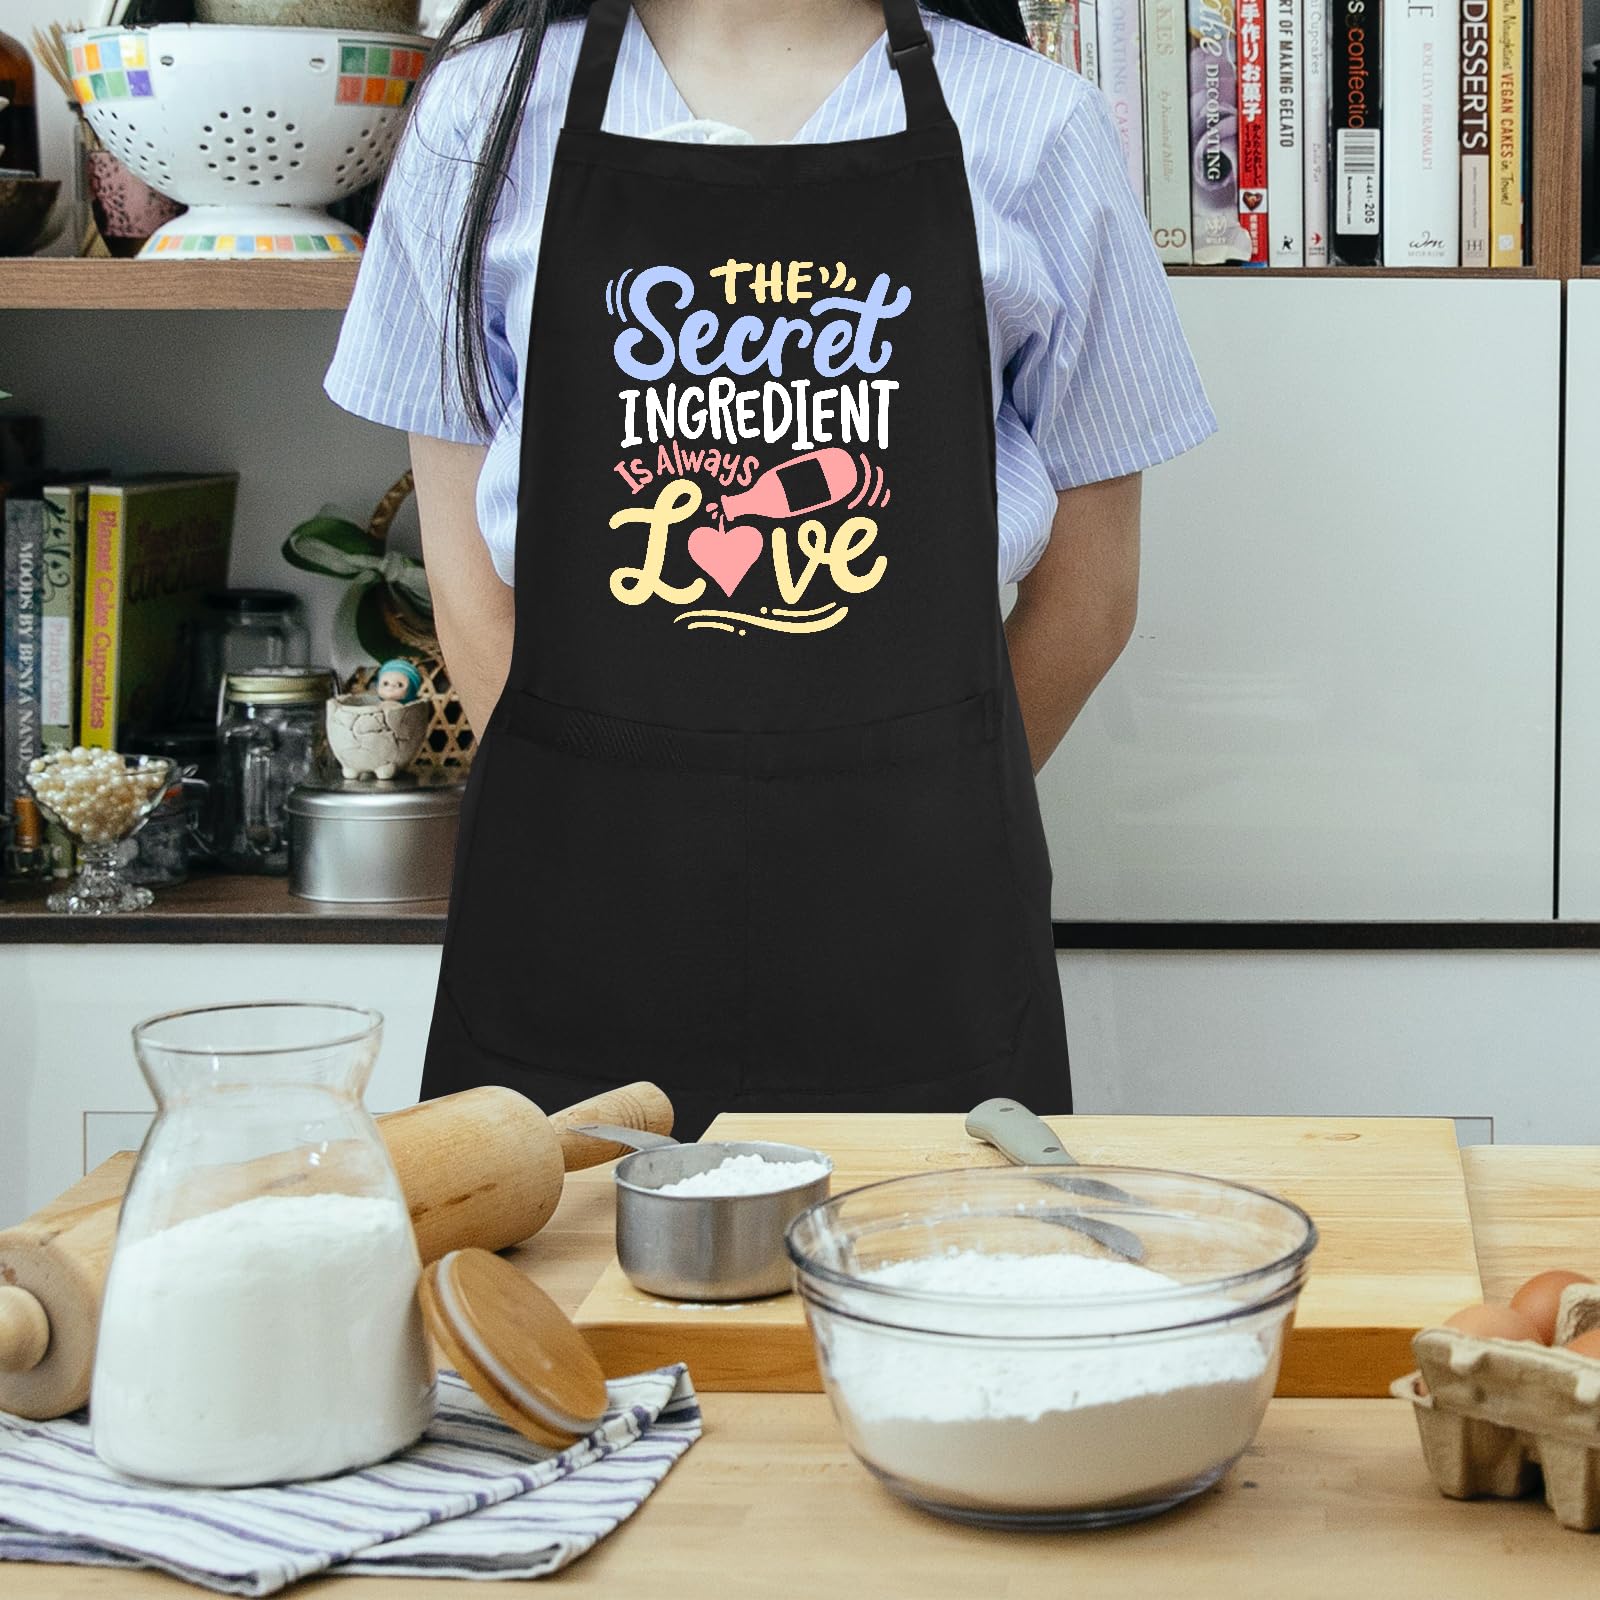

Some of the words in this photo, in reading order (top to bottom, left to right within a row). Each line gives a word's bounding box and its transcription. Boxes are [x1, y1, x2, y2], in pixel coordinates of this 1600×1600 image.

[1155, 0, 1175, 56] KES
[1279, 20, 1294, 36] OF
[1408, 0, 1434, 18] E
[1241, 0, 1262, 122] 手作りお菓子
[1279, 41, 1294, 94] MAKING
[1309, 11, 1323, 75] Cupcakes
[1349, 28, 1368, 128] confectio
[1462, 0, 1489, 149] DESSERTS
[1500, 72, 1514, 114] VEGAN
[1204, 64, 1220, 181] DECORATING
[1279, 98, 1294, 148] GELATO
[1500, 118, 1514, 159] CAKES
[1500, 160, 1513, 171] in
[1500, 175, 1515, 206] Town!
[709, 258, 814, 305] THE
[613, 265, 912, 382] Secret
[618, 376, 900, 450] INGREDIENT
[613, 458, 654, 495] Is
[656, 439, 760, 487] Always
[94, 510, 117, 572] Planet
[18, 542, 34, 609] MOODS
[92, 577, 114, 627] Cake
[18, 614, 34, 637] BY
[18, 644, 34, 704] BENYA
[48, 678, 65, 721] Cake
[87, 632, 112, 729] Cupcakes
[18, 706, 34, 773] NAND
